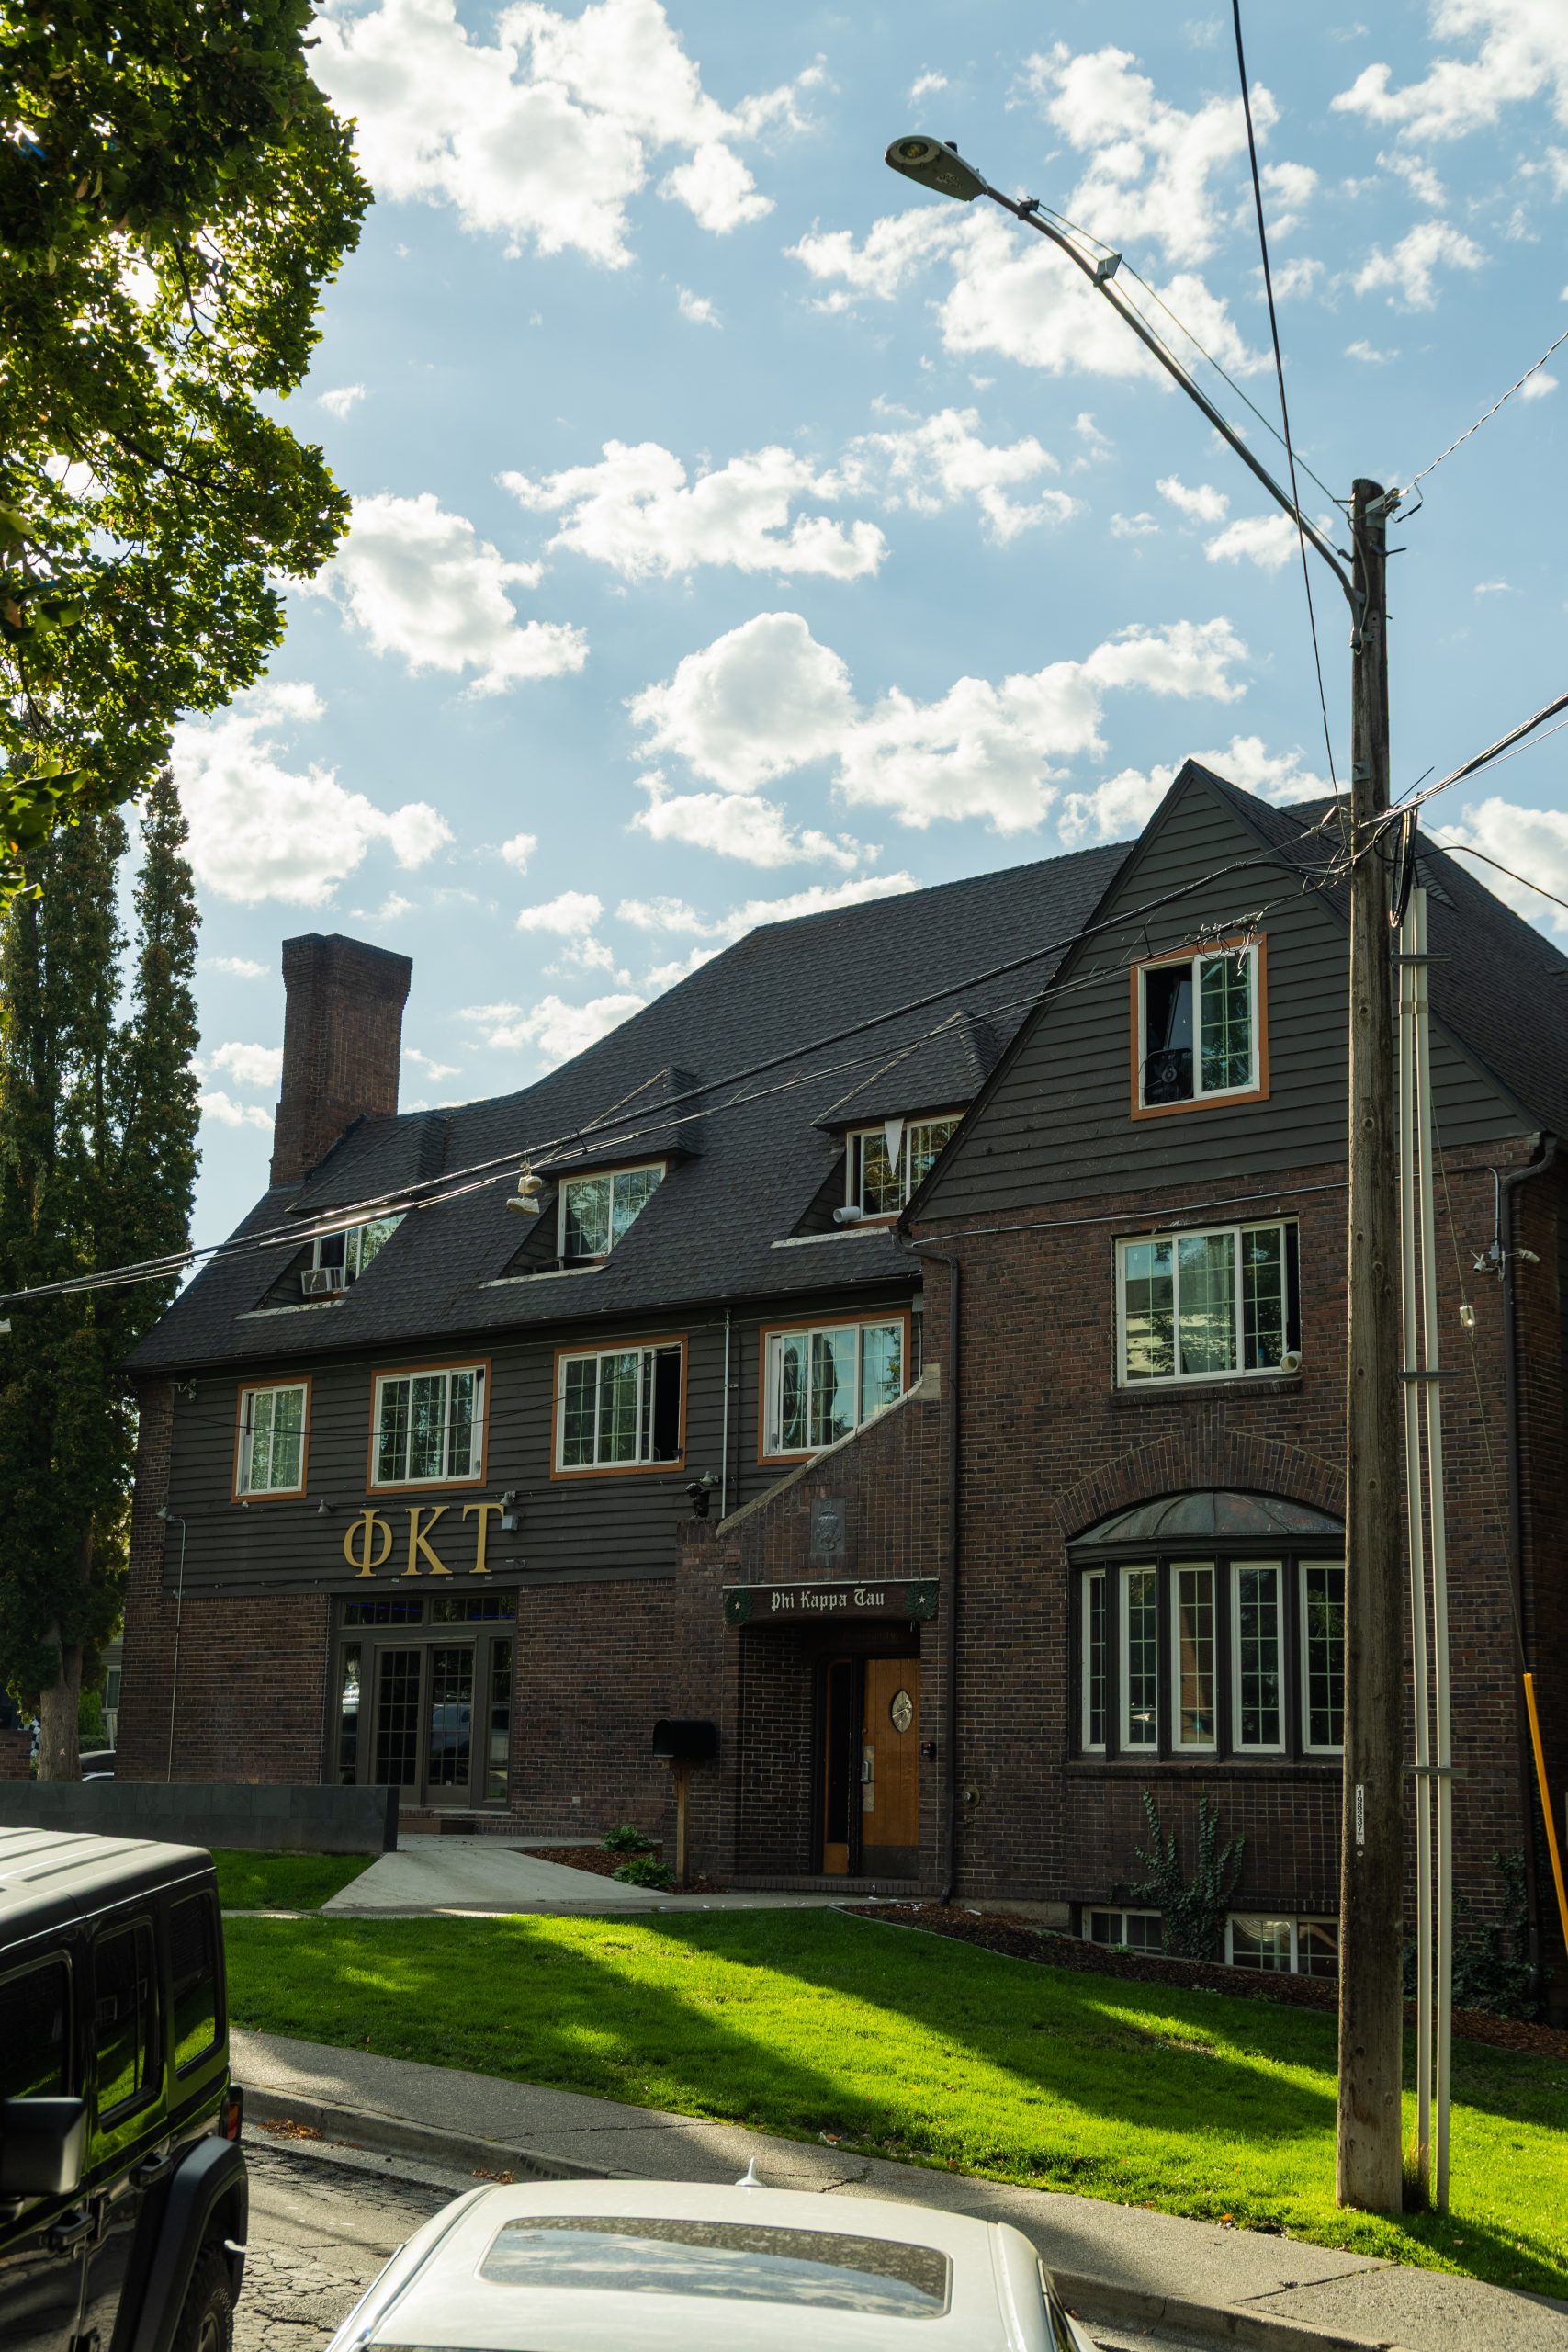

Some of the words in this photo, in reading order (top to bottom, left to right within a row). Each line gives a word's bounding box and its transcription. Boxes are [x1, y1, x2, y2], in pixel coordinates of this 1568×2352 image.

[771, 1591, 795, 1612] Phi
[800, 1590, 847, 1611] Kappa
[853, 1588, 885, 1607] Tau
